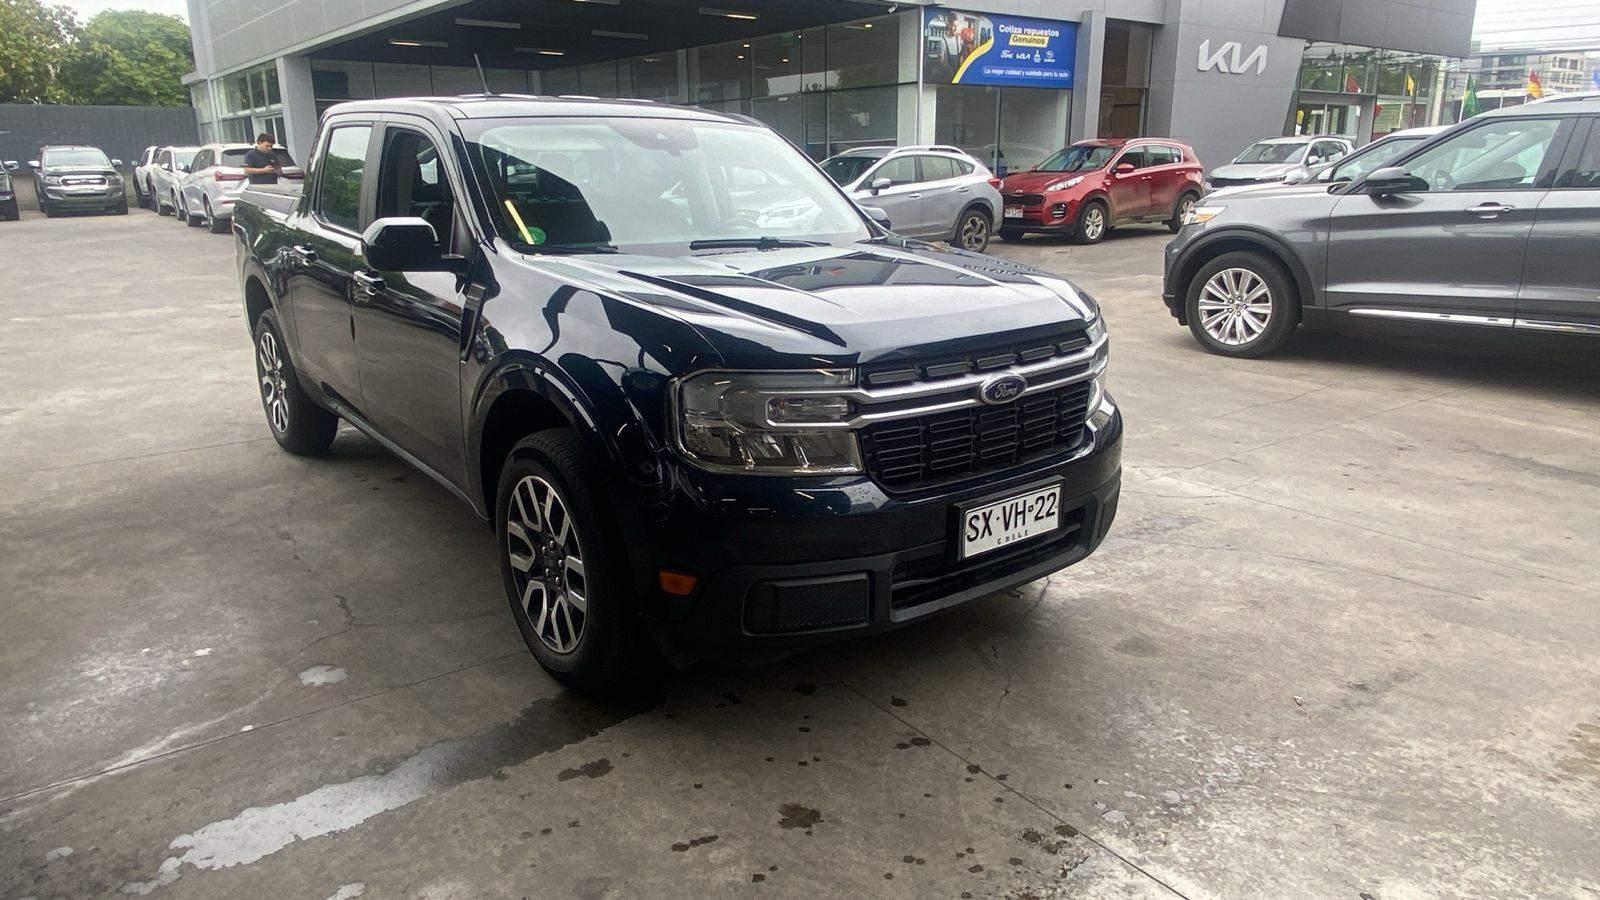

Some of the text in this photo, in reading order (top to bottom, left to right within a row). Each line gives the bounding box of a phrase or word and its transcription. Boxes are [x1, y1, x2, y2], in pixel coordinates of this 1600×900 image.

[998, 24, 1060, 37] Cotiza repuestos
[1012, 35, 1046, 45] Genuinos
[1198, 39, 1268, 75] KIA
[994, 382, 1019, 399] Ford
[997, 530, 1028, 545] CHILE
